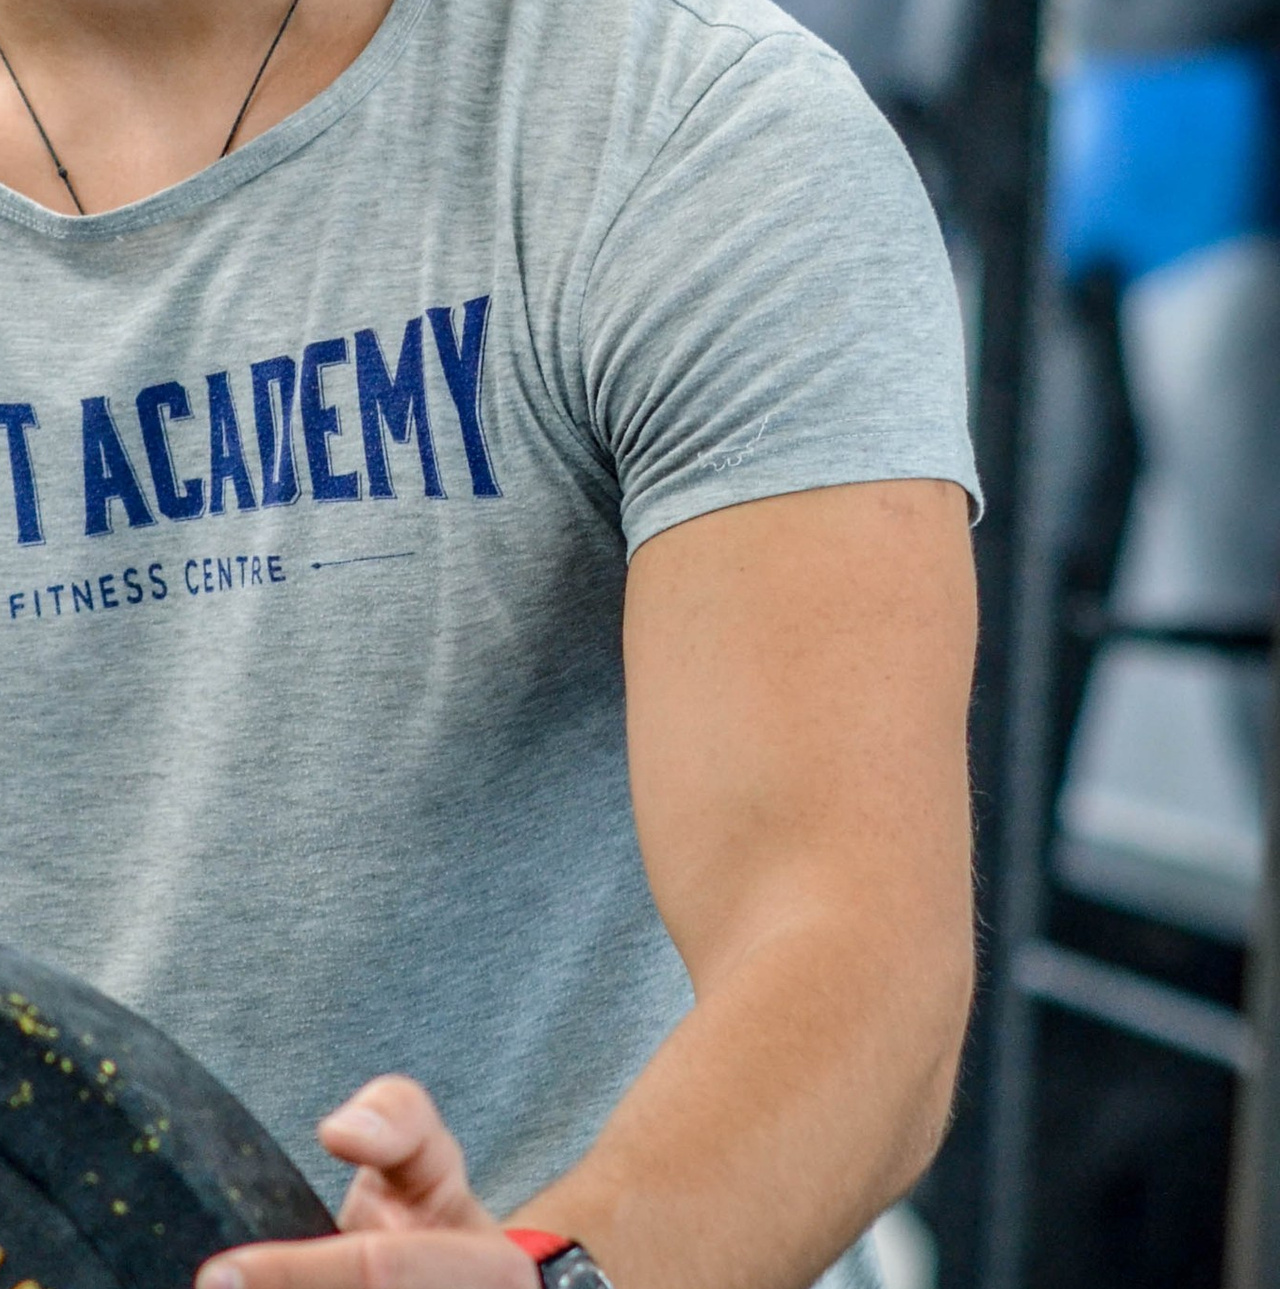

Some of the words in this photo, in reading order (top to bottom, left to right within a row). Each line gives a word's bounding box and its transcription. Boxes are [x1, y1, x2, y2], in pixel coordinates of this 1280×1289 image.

[80, 294, 503, 537] ACADEMY
[8, 562, 168, 619] FITNESS
[184, 555, 287, 596] CENTRE
